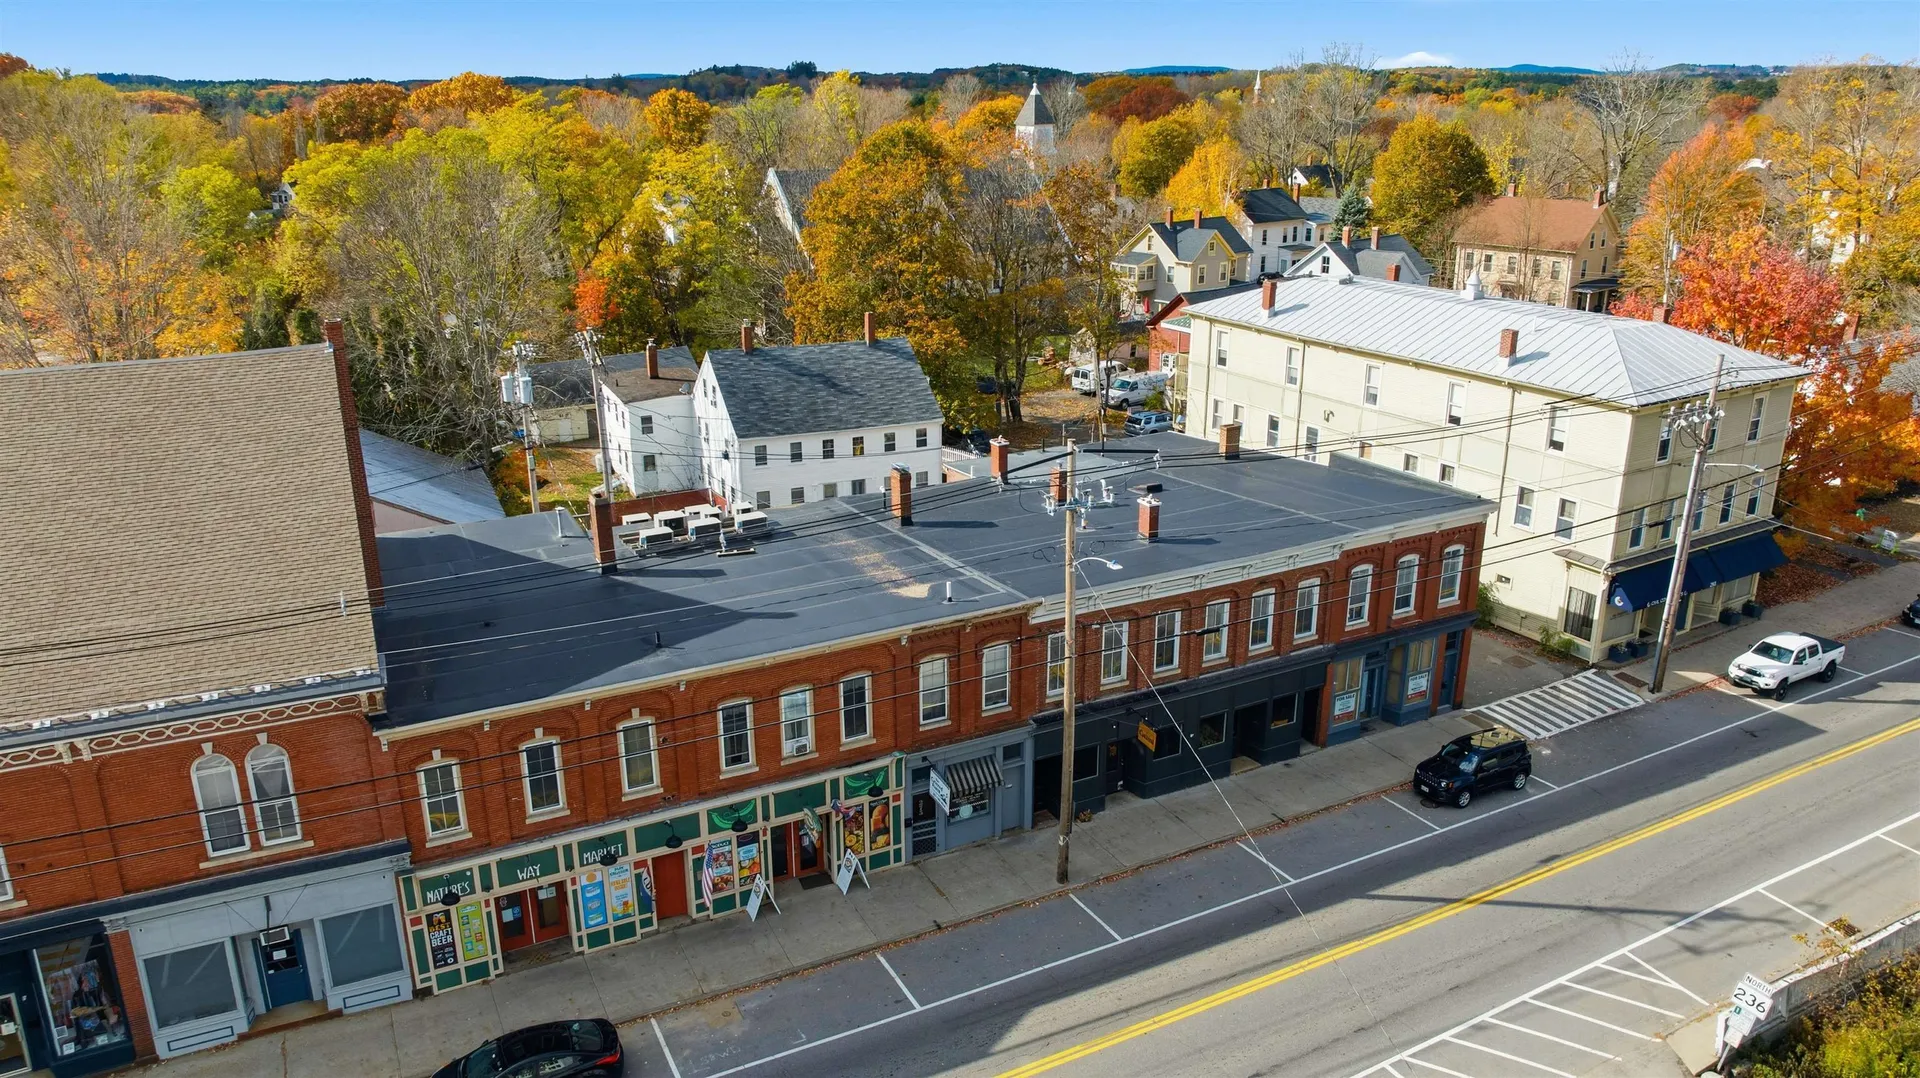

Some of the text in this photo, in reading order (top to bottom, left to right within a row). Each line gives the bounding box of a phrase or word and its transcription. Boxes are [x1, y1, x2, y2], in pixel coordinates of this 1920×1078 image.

[516, 863, 541, 881] WAY
[429, 922, 450, 932] BEST
[430, 927, 452, 939] CRAFT
[431, 935, 453, 947] BEER
[1745, 975, 1774, 995] NORTH
[1733, 987, 1766, 1014] 236
